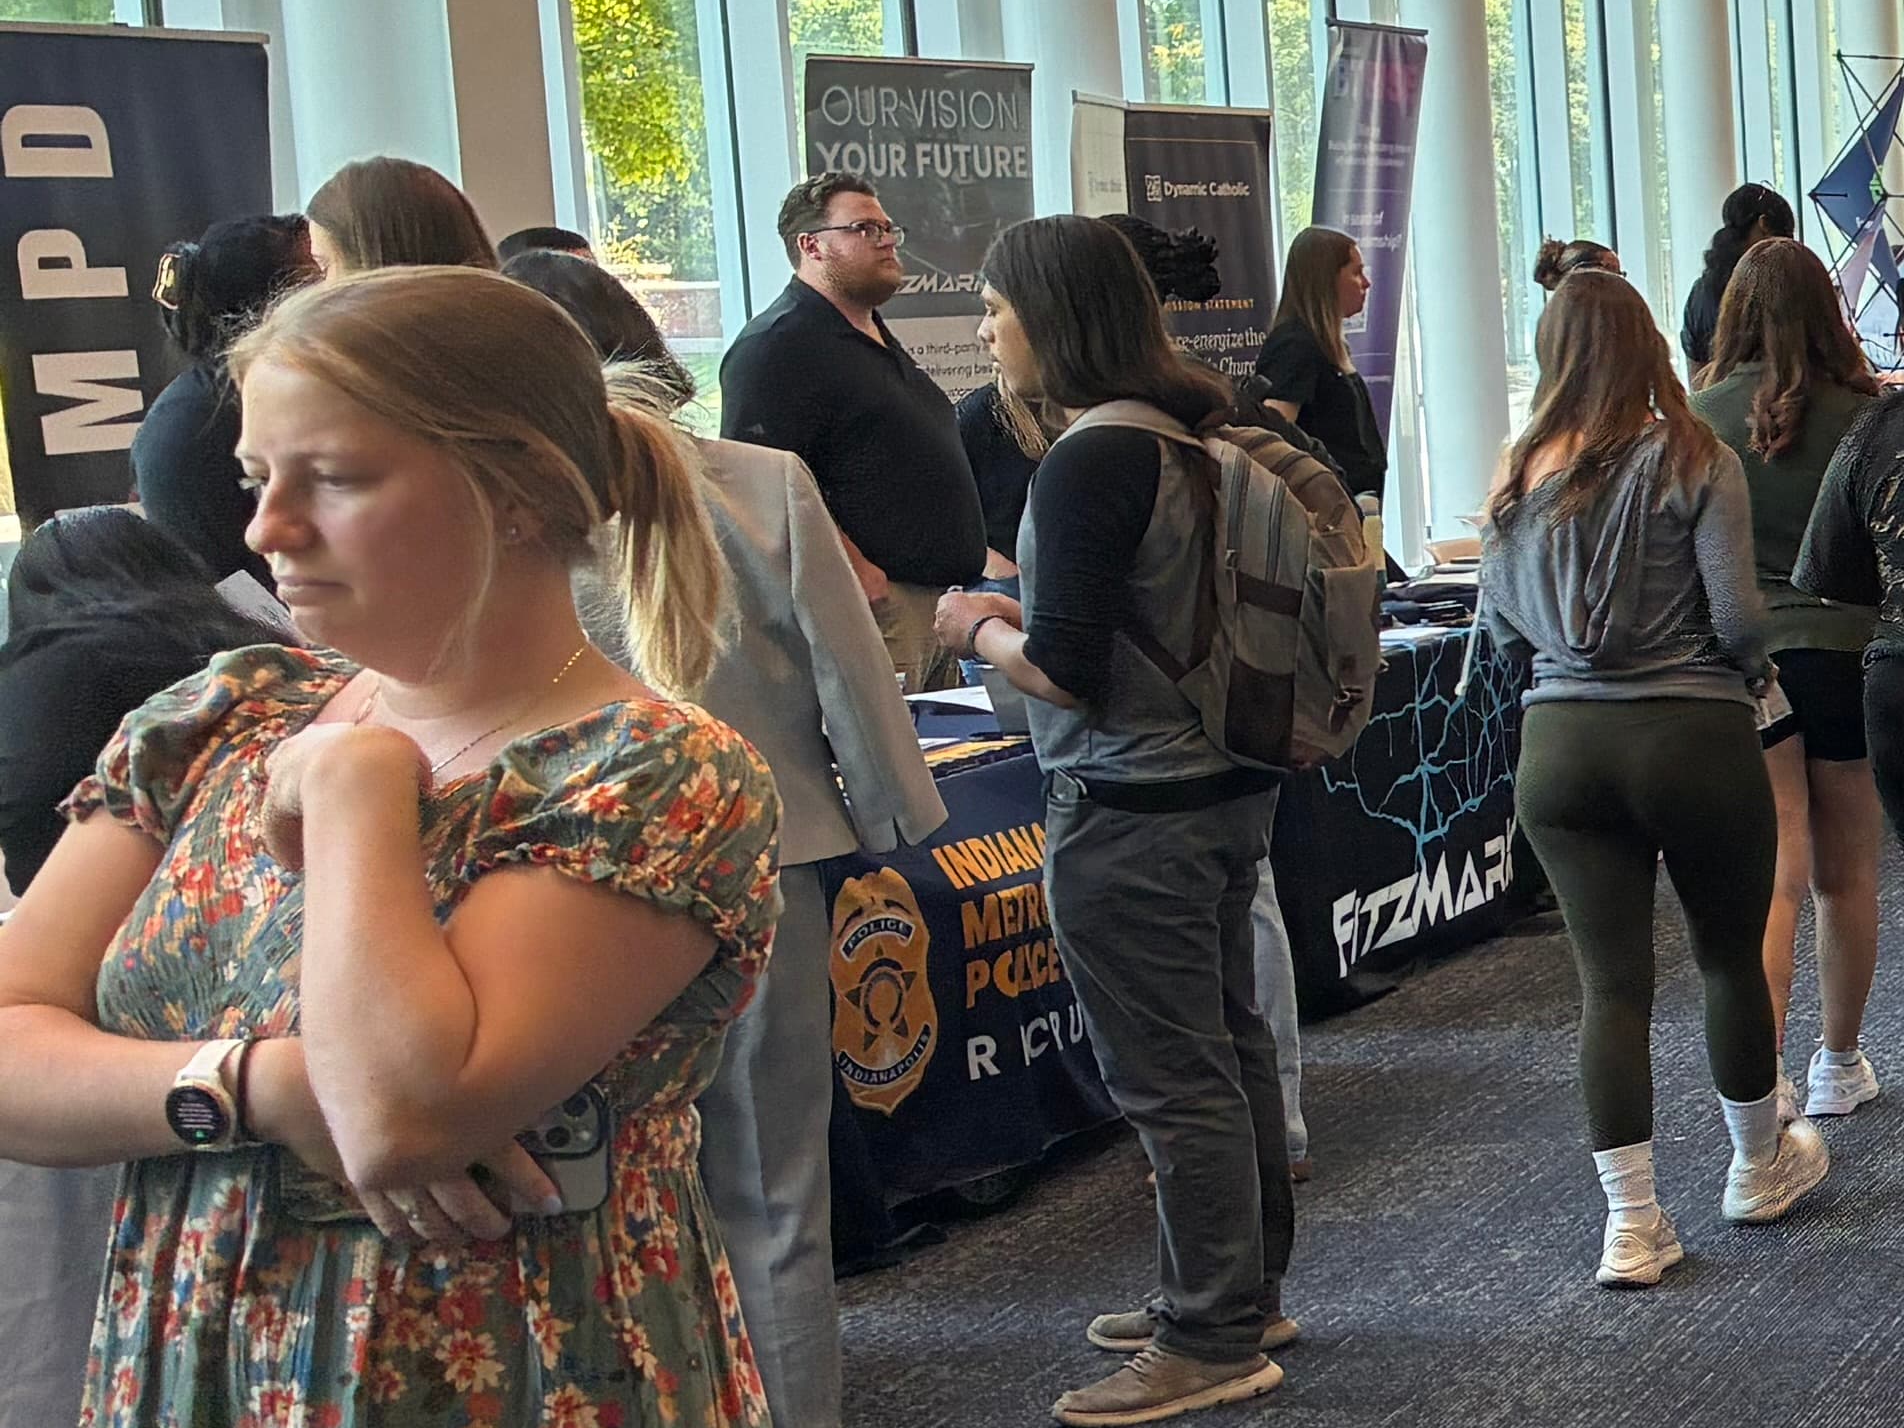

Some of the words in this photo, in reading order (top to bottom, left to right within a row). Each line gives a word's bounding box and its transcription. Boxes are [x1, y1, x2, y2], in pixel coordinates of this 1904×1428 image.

[821, 85, 898, 126] OUR
[908, 87, 1019, 130] VISION
[815, 140, 907, 178] YOUR
[915, 142, 1029, 179] FUTURE
[1164, 180, 1207, 198] Dynamic
[1208, 181, 1251, 197] Catholic
[848, 917, 912, 947] POLICE
